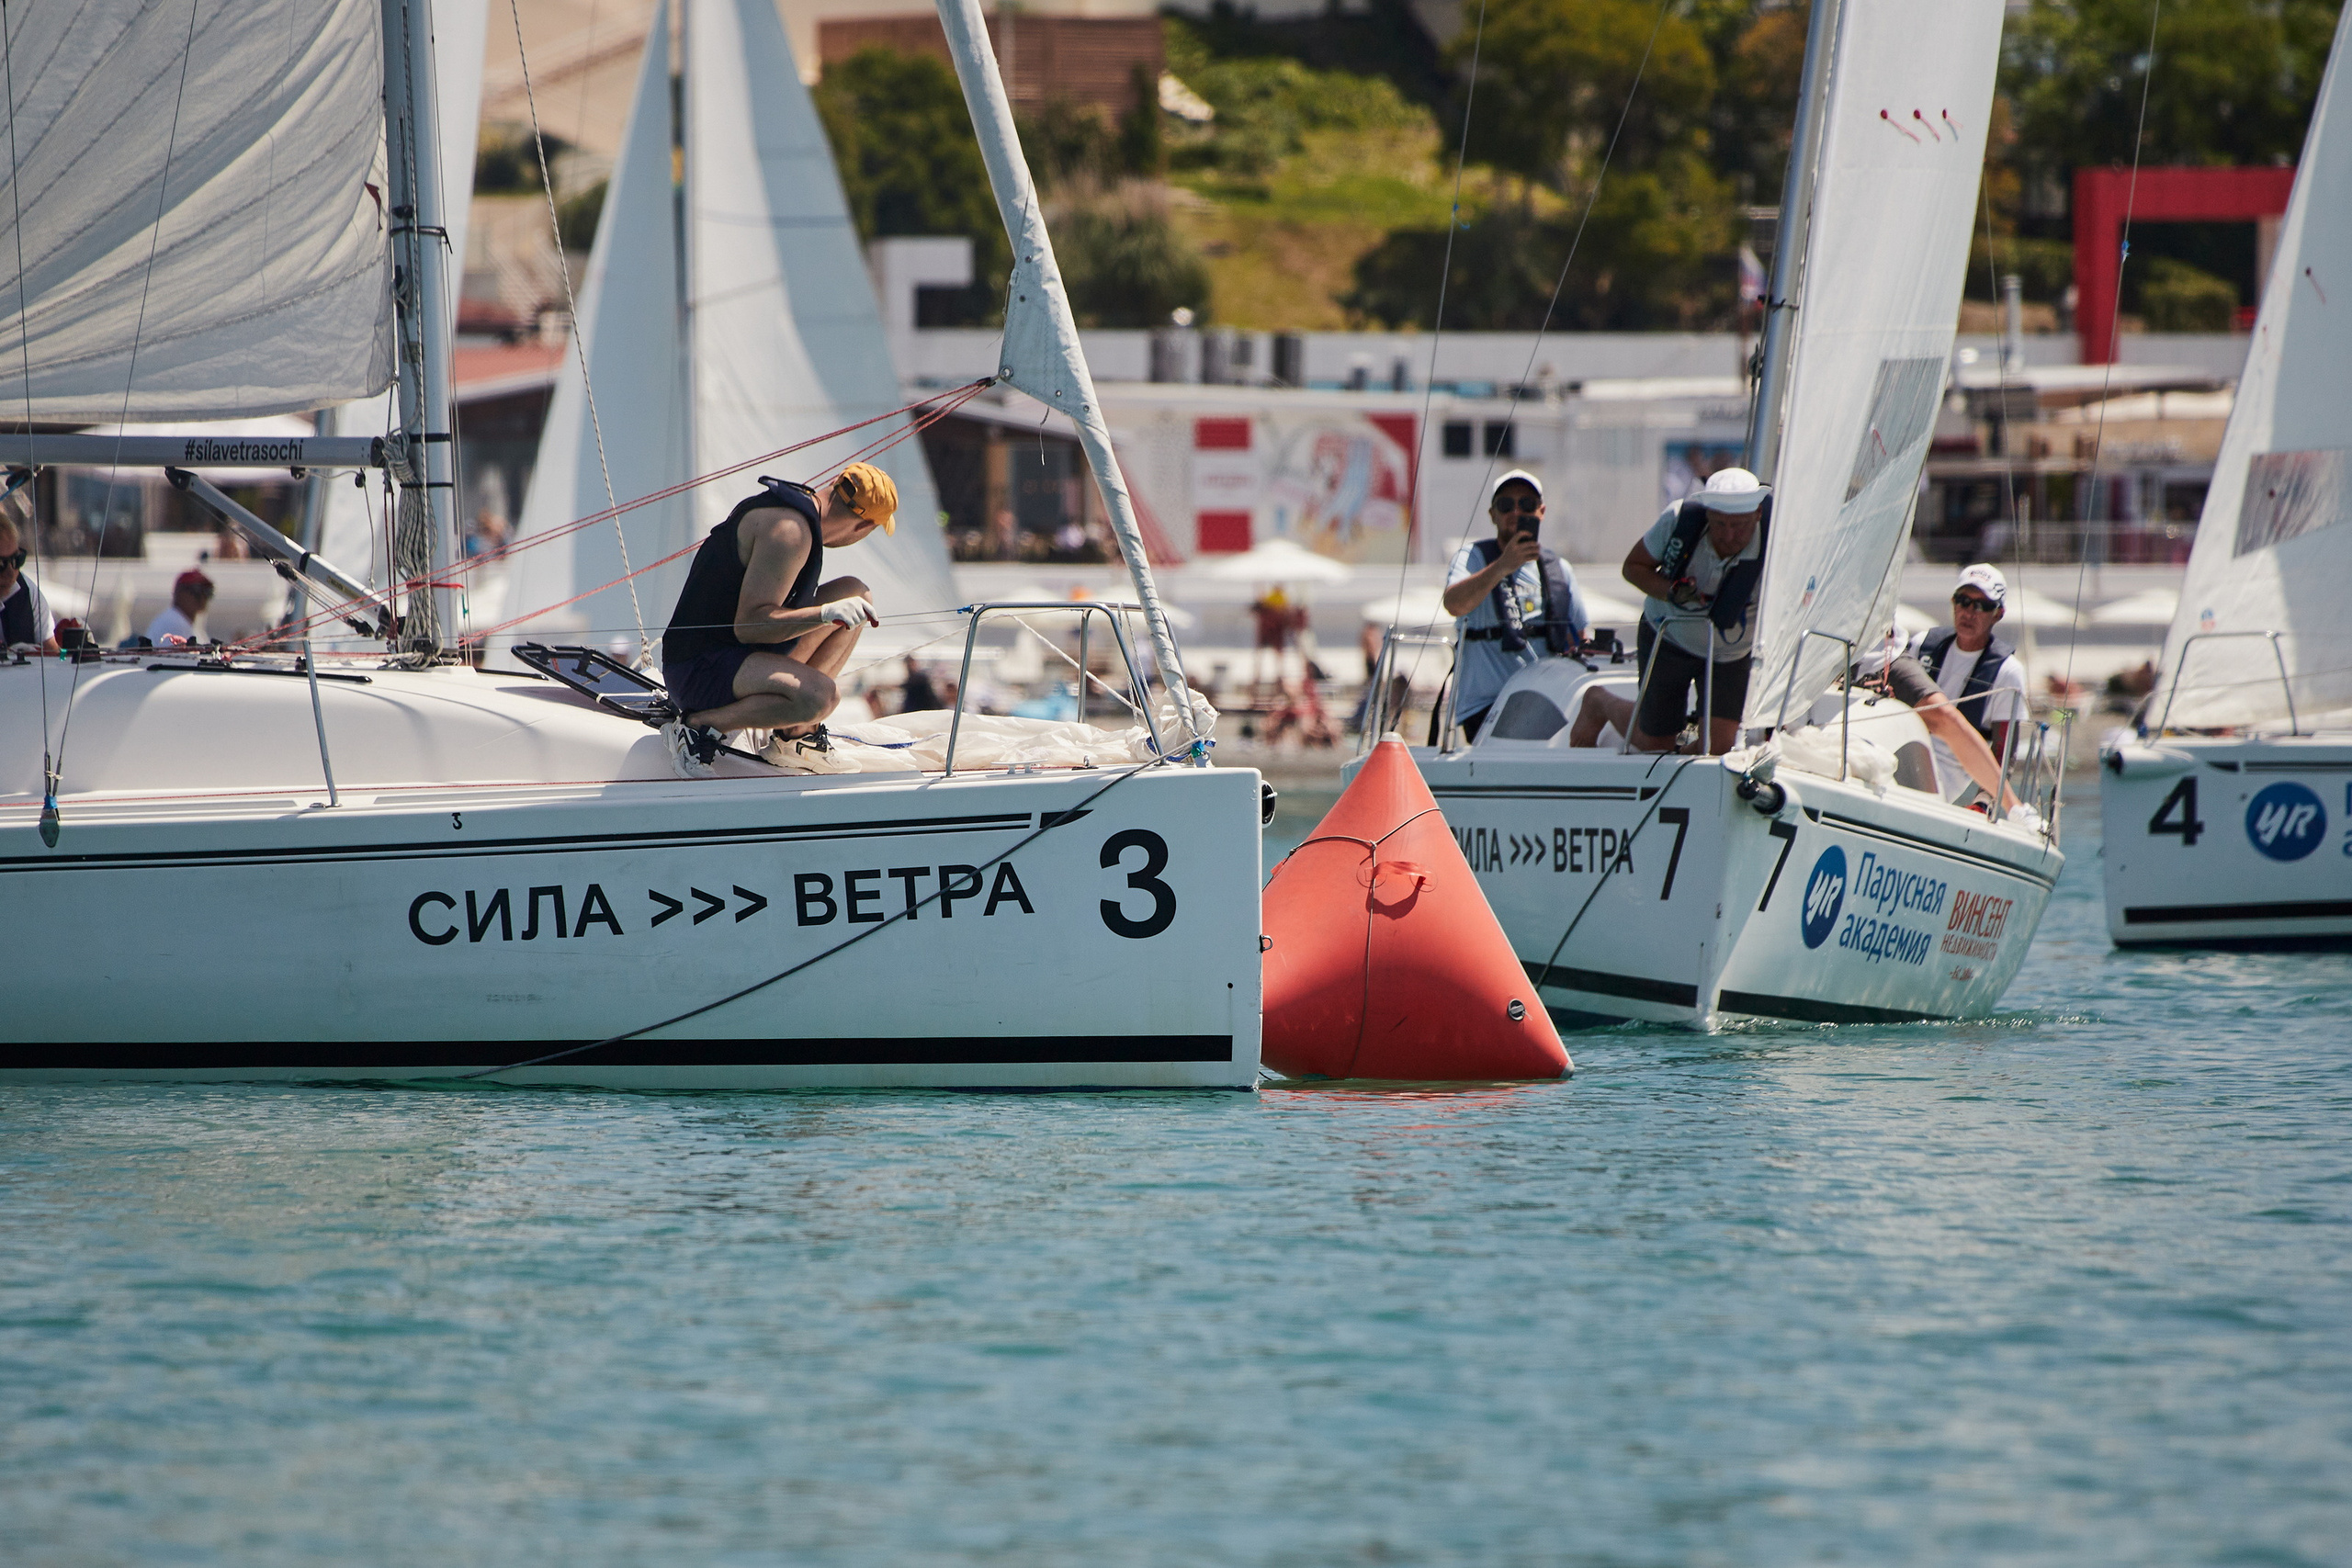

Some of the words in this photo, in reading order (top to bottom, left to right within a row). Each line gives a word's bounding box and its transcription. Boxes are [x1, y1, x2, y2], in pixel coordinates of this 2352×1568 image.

[185, 438, 303, 461] #silavetrasochi
[1499, 576, 1523, 631] SEA-P
[2148, 775, 2205, 846] 4
[1554, 827, 1634, 874] ВЕТРА
[1658, 807, 1690, 900] 7
[1758, 819, 1798, 912] 7
[408, 883, 625, 946] СИЛА
[793, 862, 1035, 927] ВЕТРА
[1099, 829, 1177, 939] 3
[1854, 851, 1948, 917] Парусная
[1947, 889, 2013, 939] ВИНСЕНТ
[1839, 913, 1933, 966] академия
